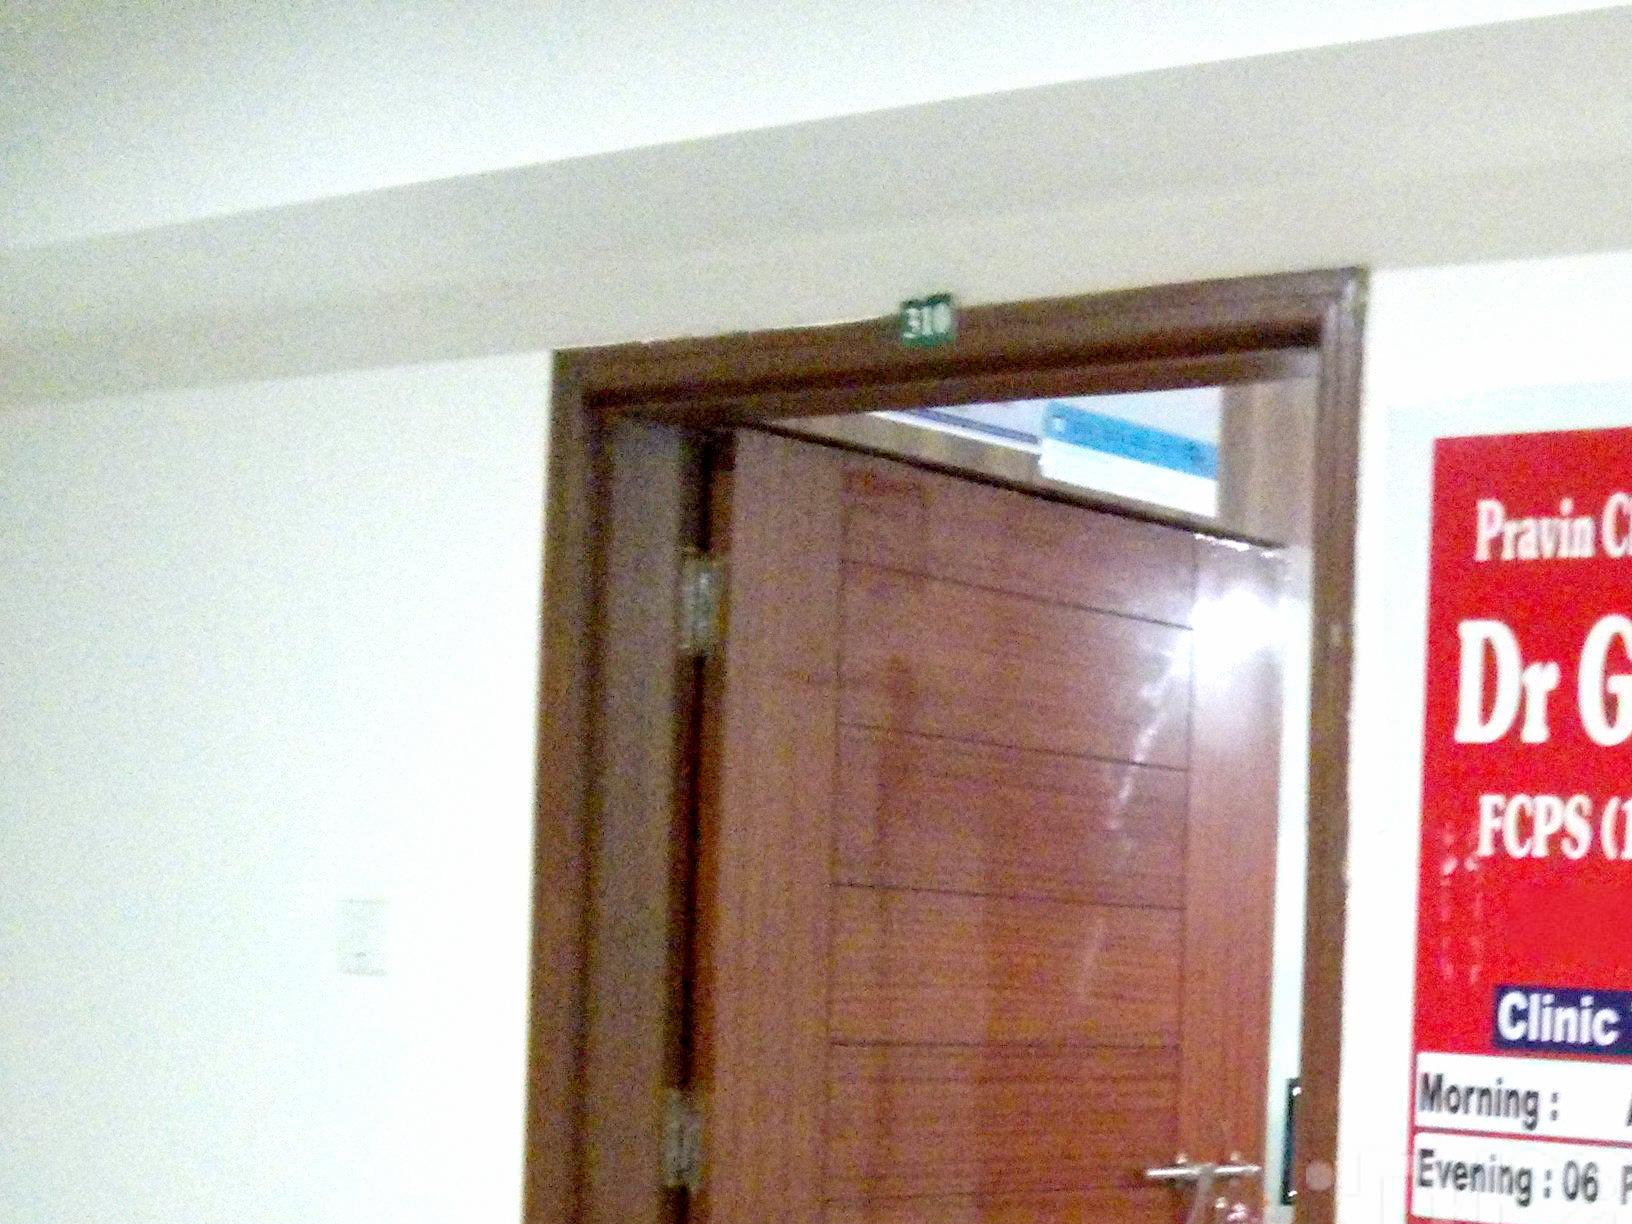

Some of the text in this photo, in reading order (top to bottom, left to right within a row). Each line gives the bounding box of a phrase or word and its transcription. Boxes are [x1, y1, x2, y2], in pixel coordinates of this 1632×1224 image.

[1474, 498, 1594, 561] Pravin
[1454, 619, 1560, 744] Dr
[1477, 795, 1592, 859] FCPS
[1496, 992, 1622, 1047] Clinic
[1561, 1160, 1600, 1203] 06
